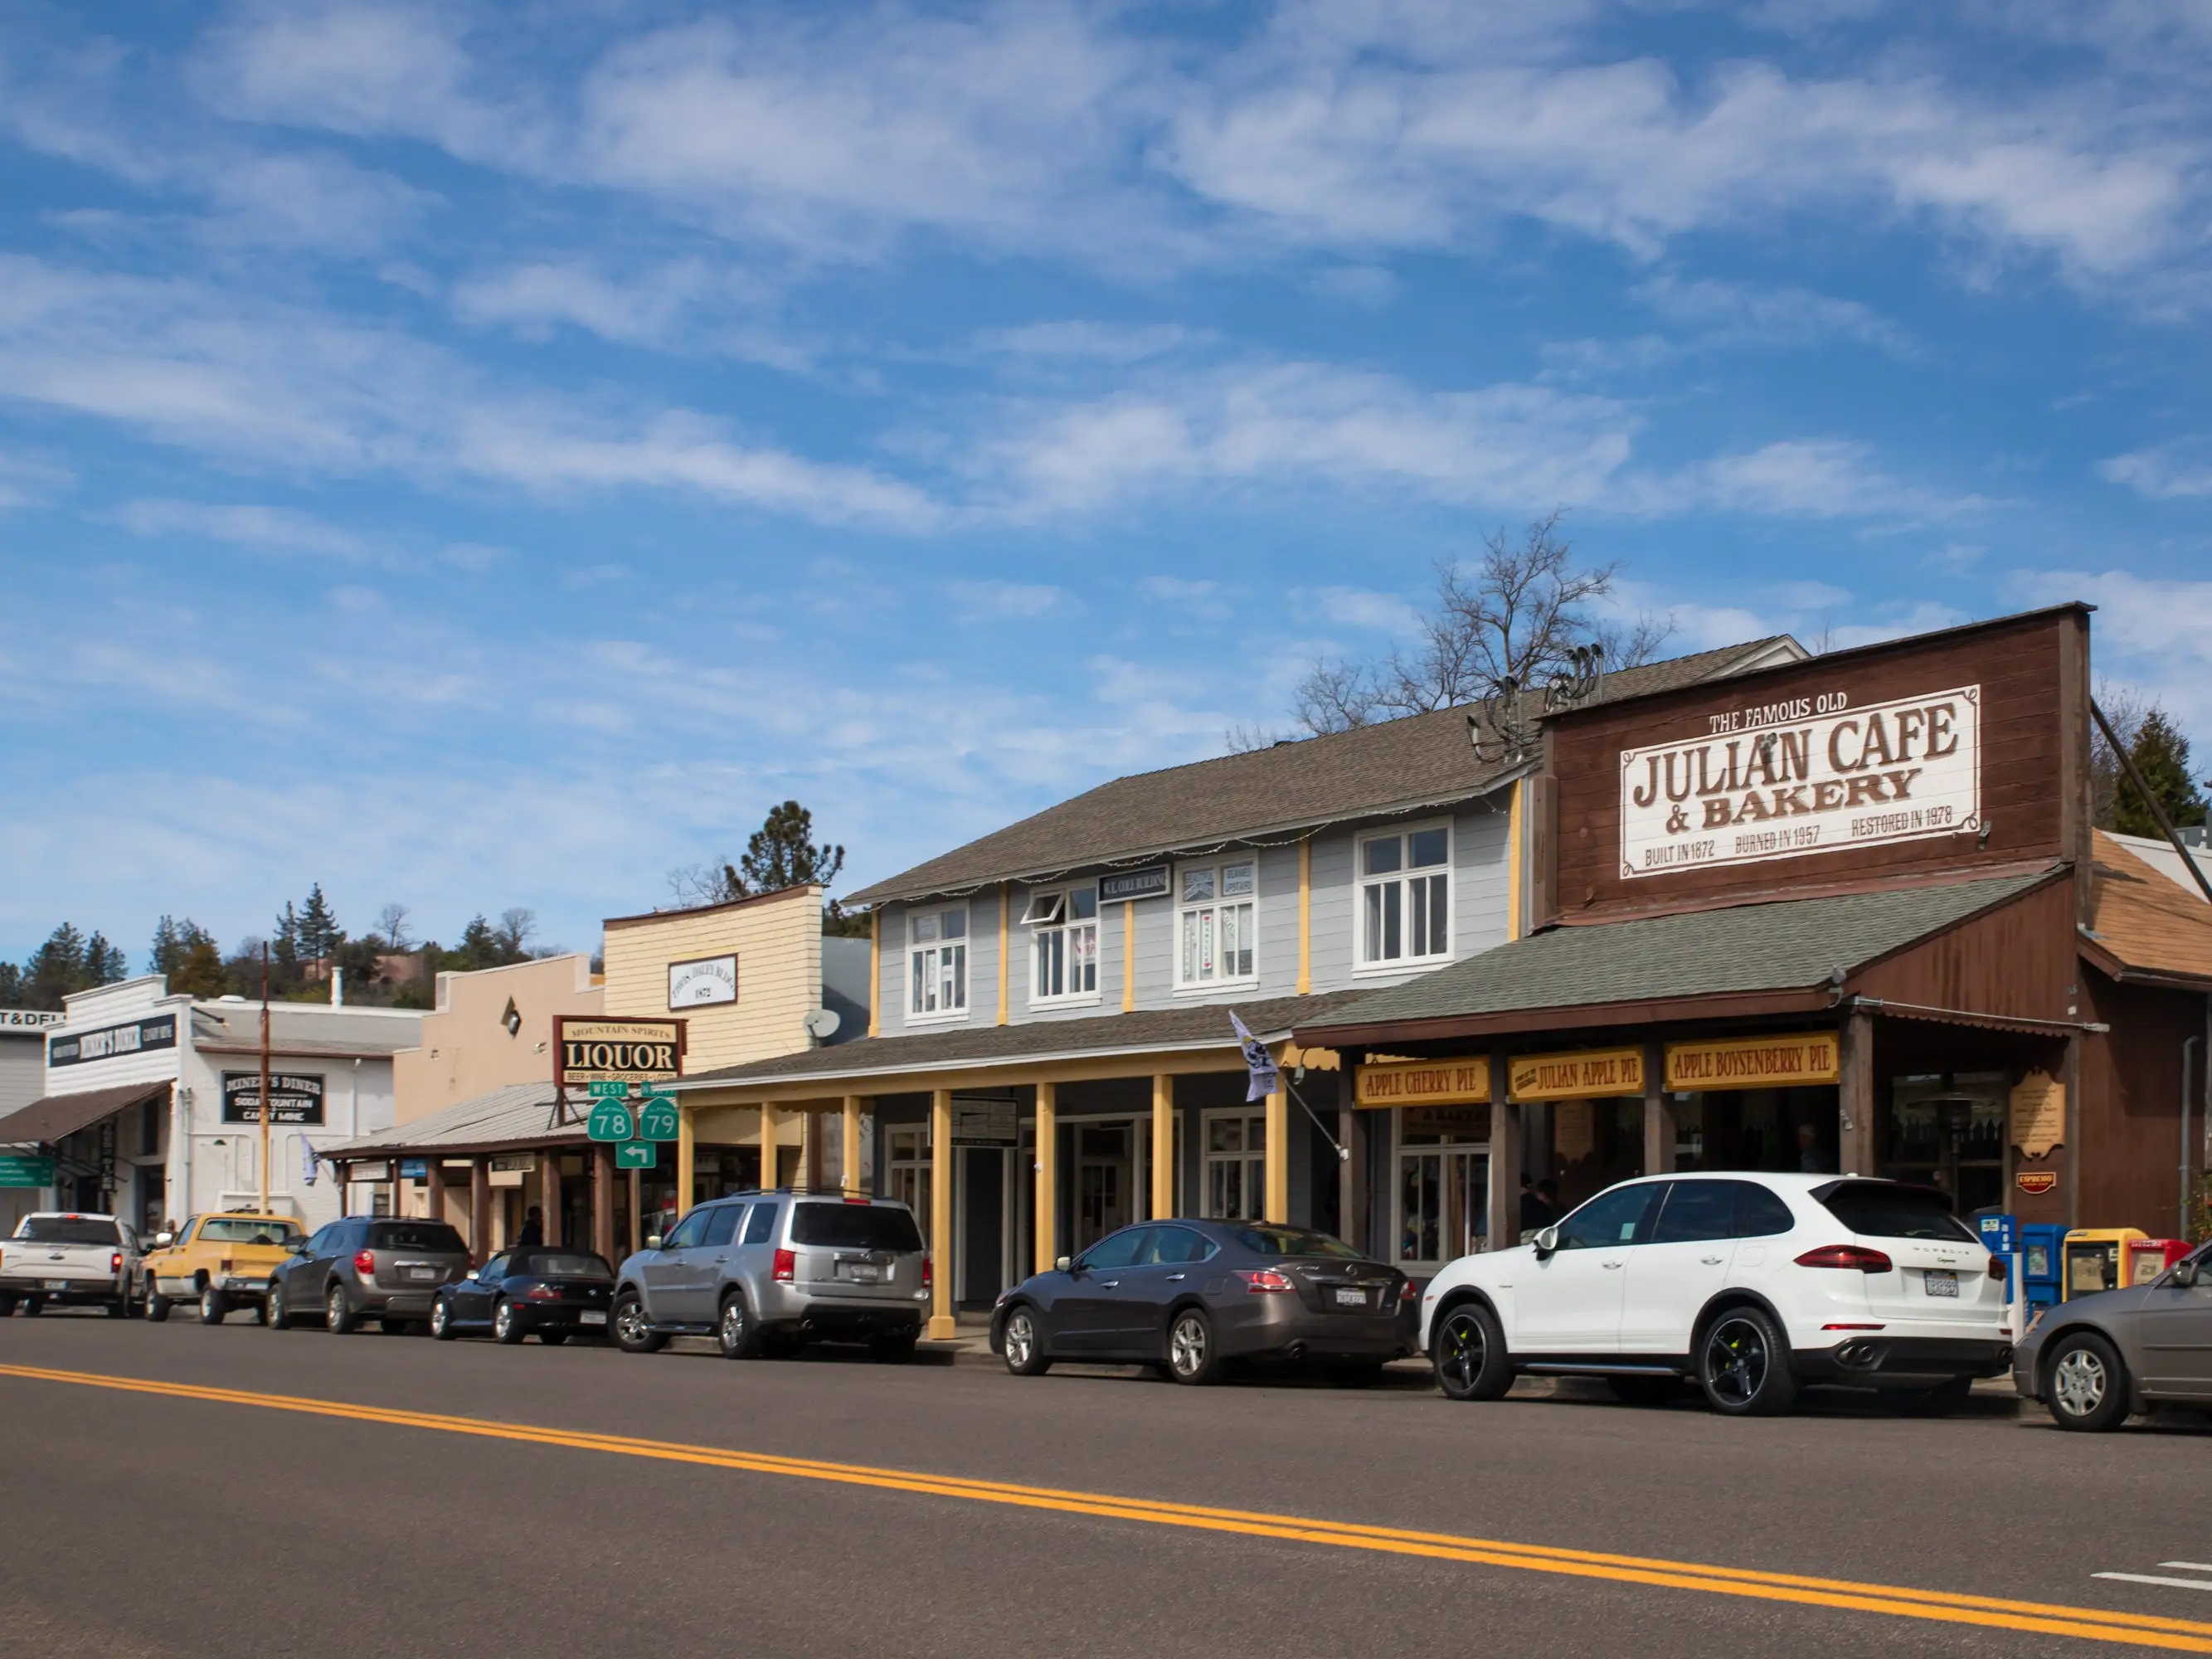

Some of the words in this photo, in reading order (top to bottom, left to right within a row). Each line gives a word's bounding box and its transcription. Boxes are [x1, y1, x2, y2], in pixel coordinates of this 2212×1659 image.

[1709, 713, 1740, 734] THE
[1745, 697, 1811, 728] FAMOUS
[1816, 692, 1848, 714] OLD
[1633, 727, 1813, 809] JULIAN
[1828, 702, 1959, 776] CAFE
[1665, 804, 1692, 835] &
[1701, 767, 1923, 831] BAKERY
[1645, 844, 1674, 867] BUILT
[1677, 843, 1689, 862] IN
[1691, 840, 1715, 859] 1872
[1735, 830, 1777, 854] BURNED
[1779, 830, 1791, 846] IN
[1794, 825, 1821, 845] 1957
[1851, 811, 1908, 837] RESTORED
[1910, 810, 1923, 828] IN
[1926, 805, 1953, 825] 1978
[571, 1025, 630, 1037] MOUNTAIN
[631, 1027, 672, 1039] SPIRITS
[566, 1044, 674, 1070] LIQUOR
[1675, 1052, 1714, 1079] APPLE
[1715, 1046, 1804, 1077] BOYSENBERRY
[1808, 1044, 1830, 1072] PIE
[226, 1076, 279, 1092] MINE'S
[282, 1077, 321, 1095] DINER
[1366, 1072, 1402, 1097] APPLE
[1405, 1068, 1452, 1095] CHERRY
[1456, 1067, 1476, 1092] PIE
[1537, 1063, 1578, 1090] JULIAN
[1583, 1059, 1616, 1087] APPLE
[1621, 1058, 1638, 1083] PIE
[234, 1097, 261, 1106] SODA
[593, 1083, 623, 1094] WEST
[595, 1115, 626, 1135] 78
[646, 1115, 675, 1135] 79
